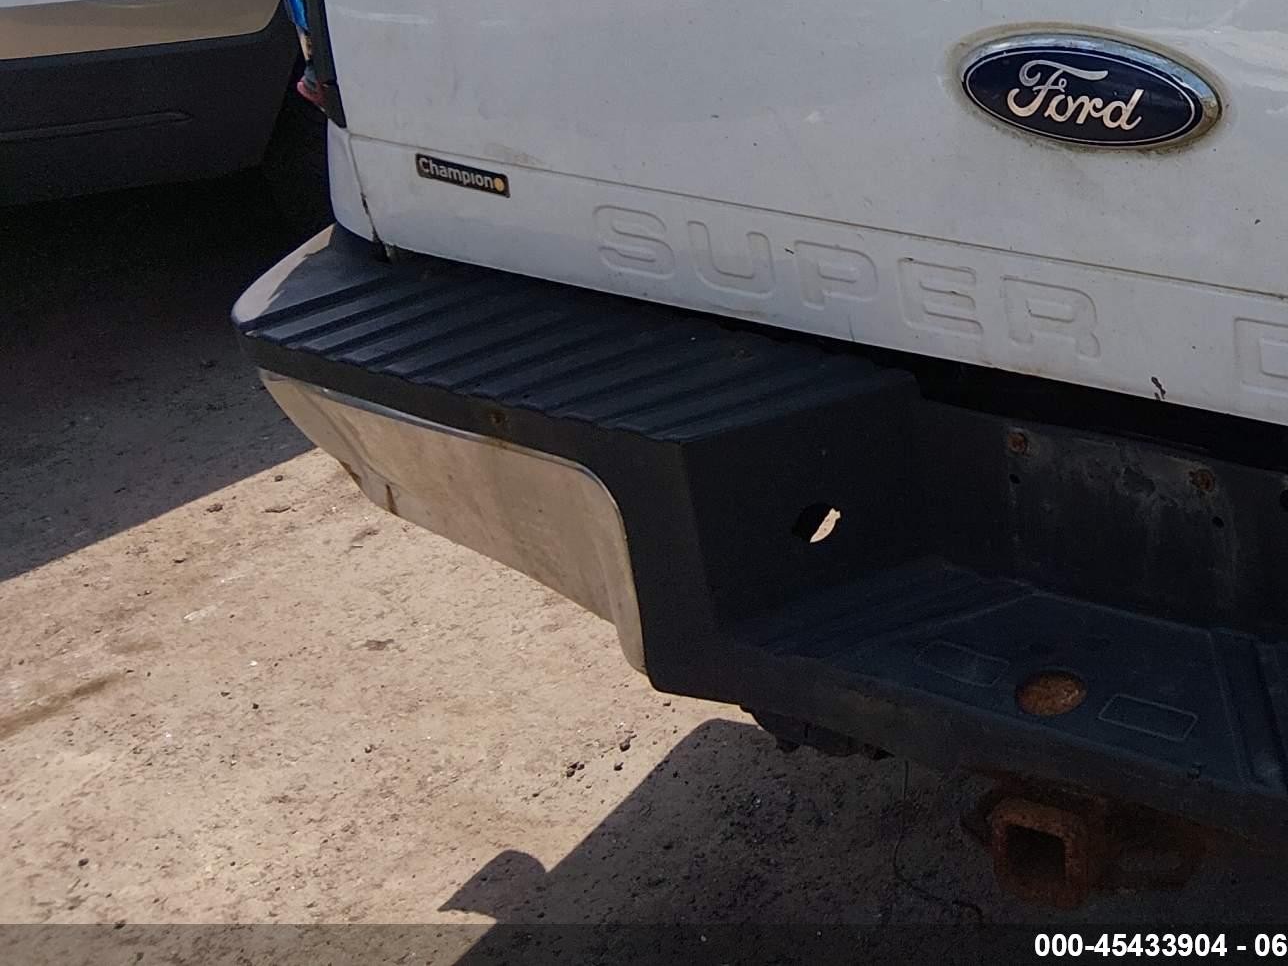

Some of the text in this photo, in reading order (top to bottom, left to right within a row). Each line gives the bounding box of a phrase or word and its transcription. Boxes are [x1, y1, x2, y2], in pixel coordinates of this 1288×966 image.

[1007, 59, 1144, 131] Ford
[418, 157, 494, 189] Champion
[592, 204, 1099, 358] SUPER
